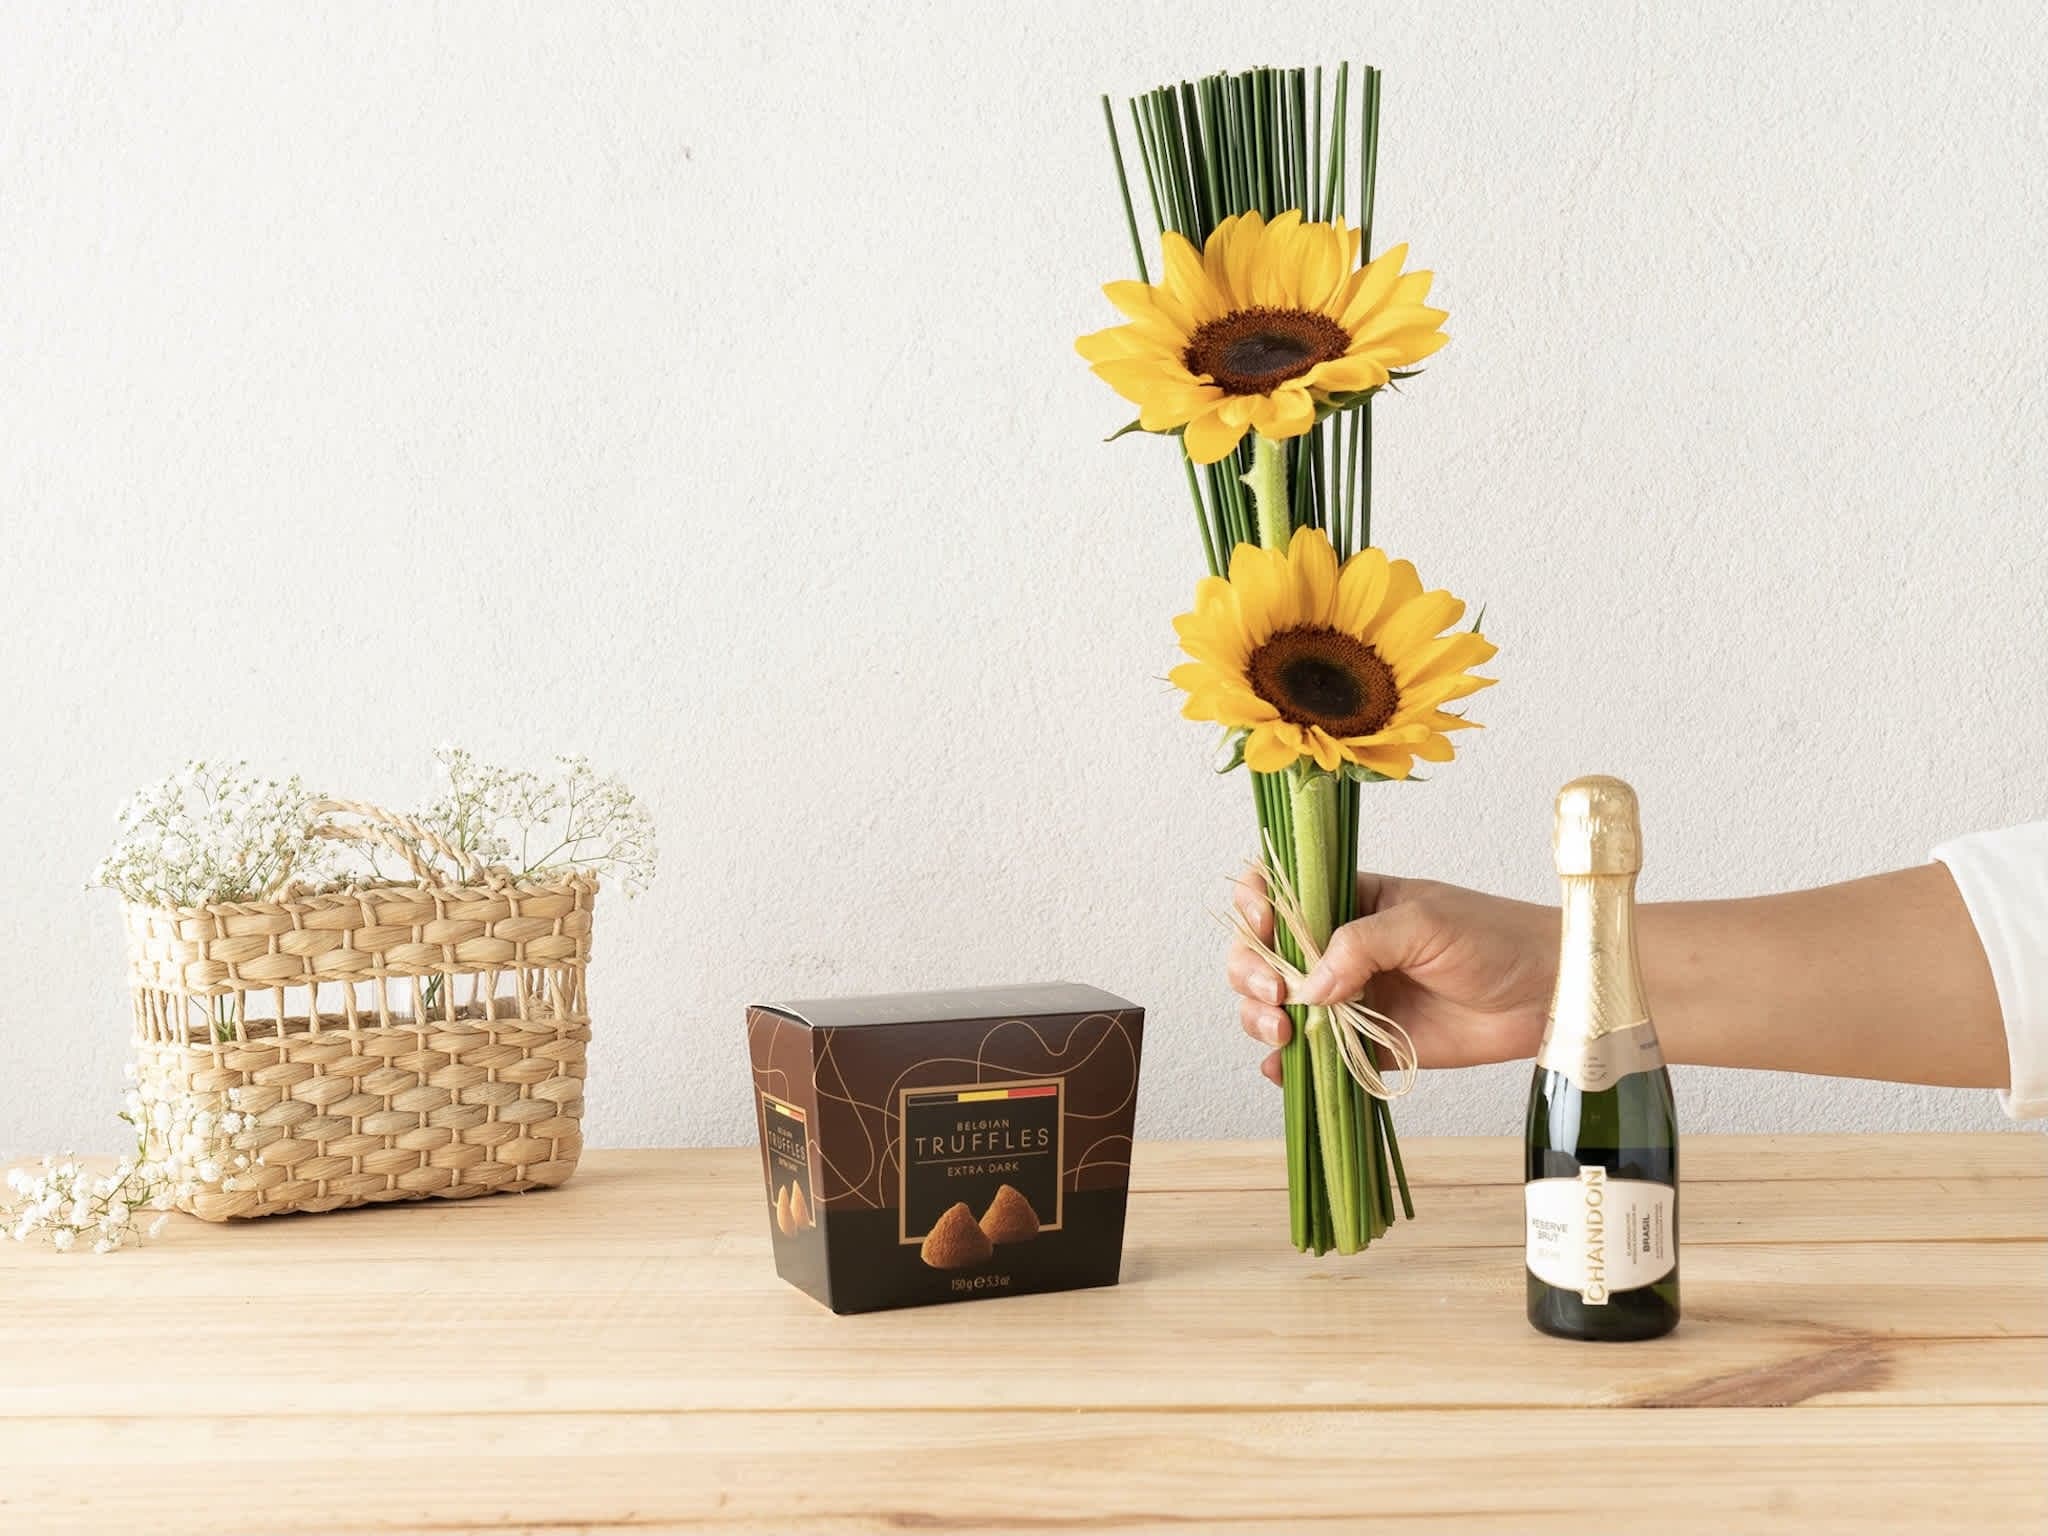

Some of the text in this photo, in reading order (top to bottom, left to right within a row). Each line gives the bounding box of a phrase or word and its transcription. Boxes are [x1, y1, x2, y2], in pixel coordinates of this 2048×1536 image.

[957, 1120, 1009, 1131] BELGIAN
[915, 1128, 1049, 1156] TRUFFLES
[948, 1161, 1019, 1176] EXTRA DARK
[1532, 1217, 1568, 1233] RESERVE
[1641, 1214, 1651, 1252] BRASIL
[1537, 1230, 1560, 1243] BRUT
[1585, 1169, 1605, 1302] CHANDON
